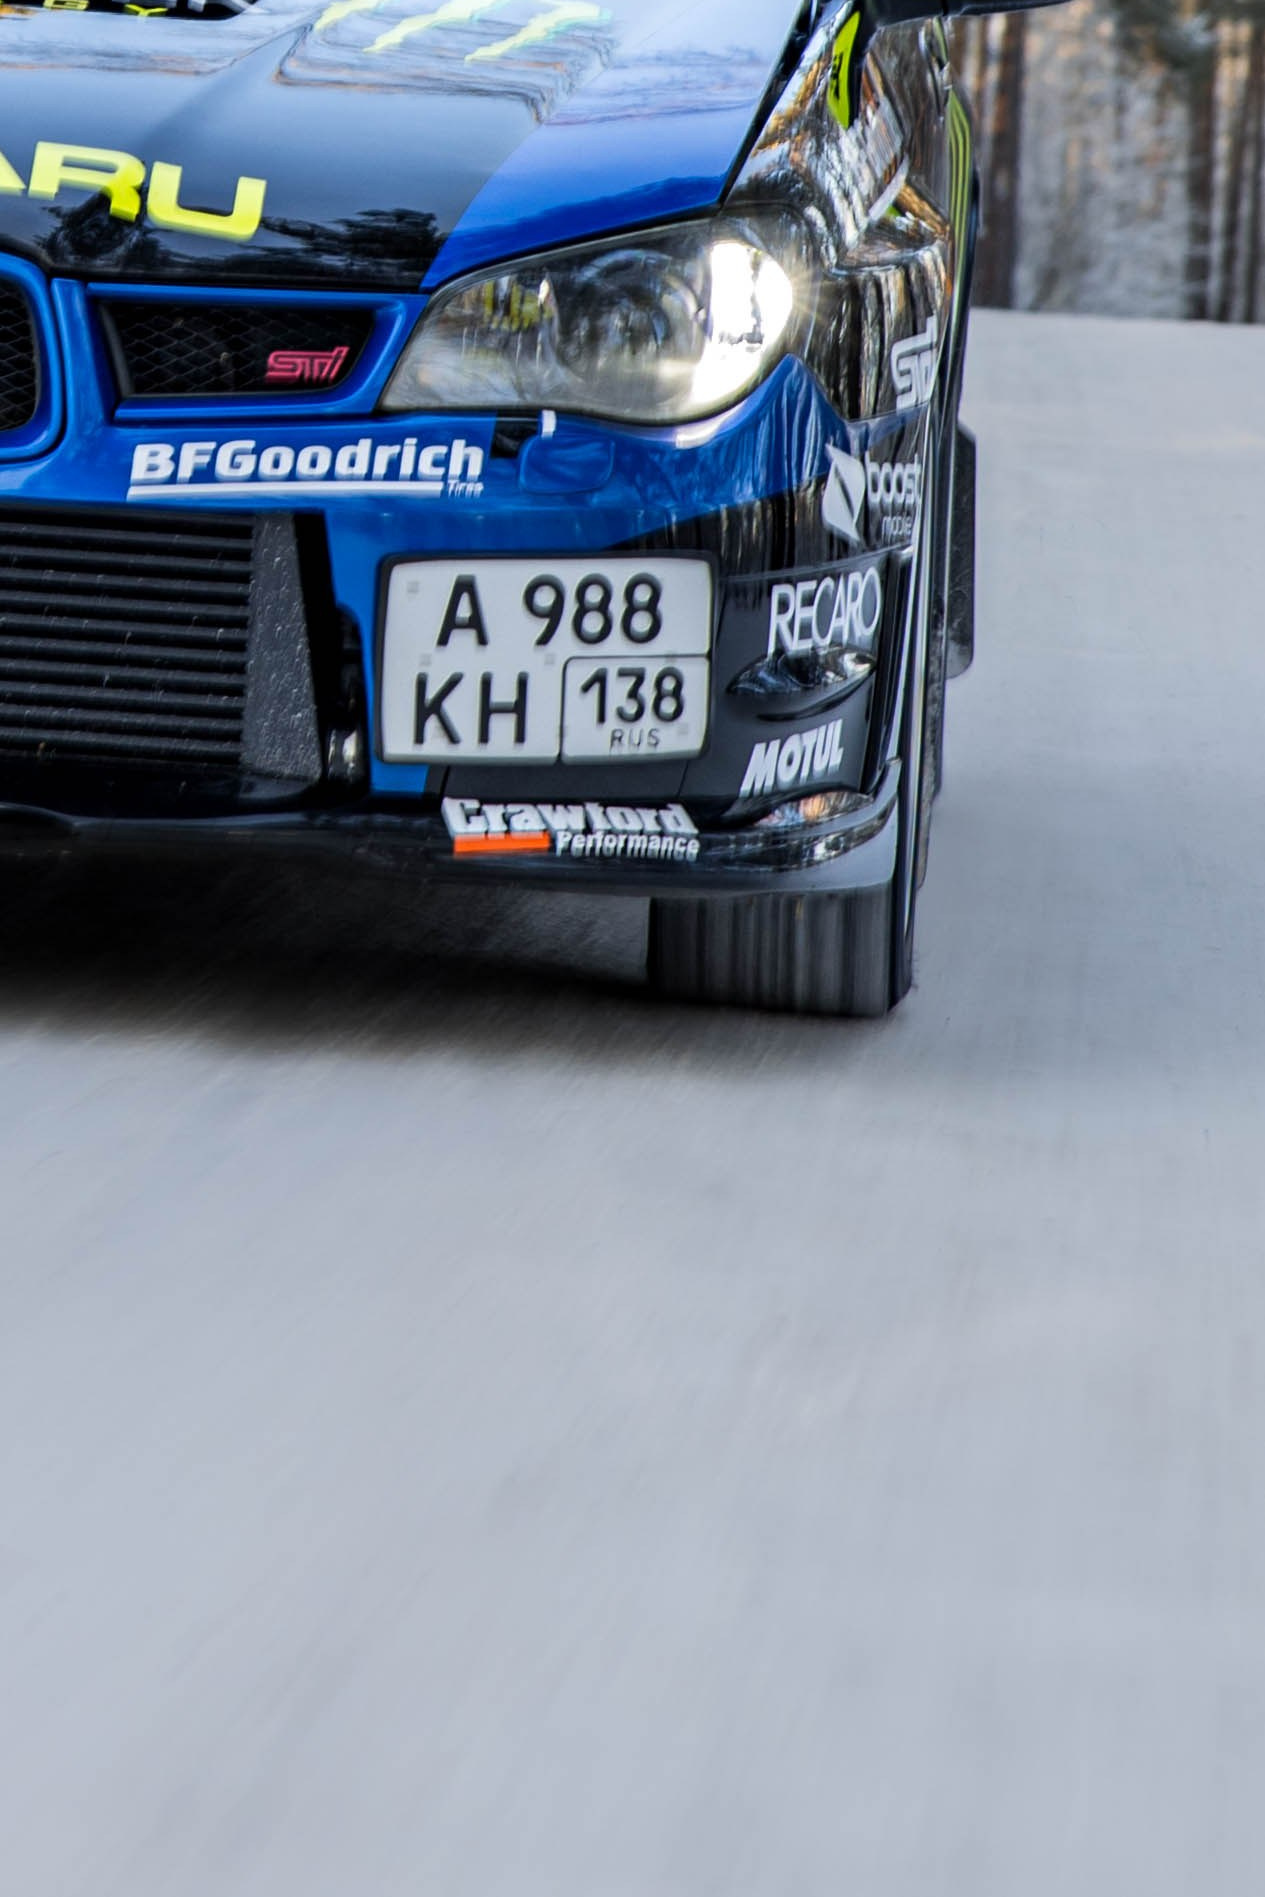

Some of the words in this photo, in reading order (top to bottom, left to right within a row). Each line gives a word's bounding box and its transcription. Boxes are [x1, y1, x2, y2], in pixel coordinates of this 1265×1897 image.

[129, 438, 484, 484] BFGoodrich
[436, 574, 488, 646] A
[522, 571, 663, 646] 988
[767, 567, 882, 657] RECARO
[413, 670, 530, 745] KH
[580, 665, 685, 725] 138
[610, 727, 660, 749] RUS
[739, 718, 845, 798] MOTUL
[441, 796, 700, 837] Crawford
[555, 829, 701, 861] Performance
